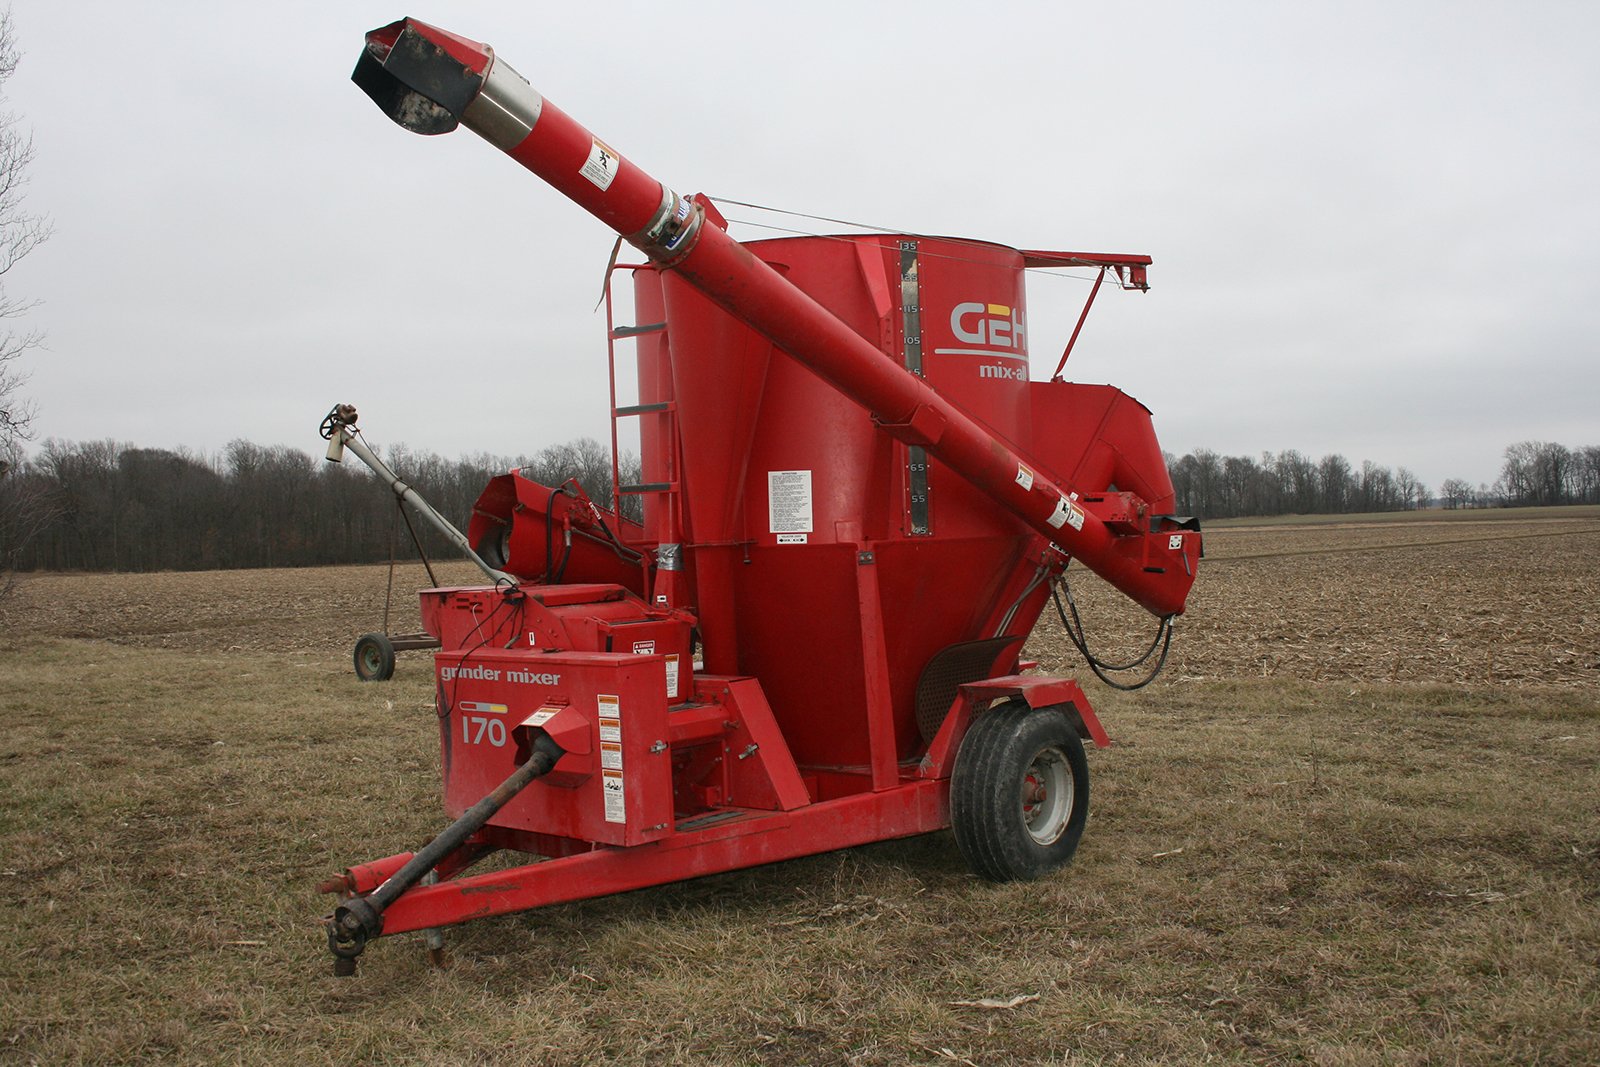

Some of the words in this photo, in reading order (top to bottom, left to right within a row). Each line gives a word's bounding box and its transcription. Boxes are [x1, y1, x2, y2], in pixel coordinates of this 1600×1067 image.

[900, 242, 916, 250] 135
[904, 305, 918, 313] 115
[903, 337, 920, 345] 105
[910, 463, 925, 472] 65
[911, 495, 925, 503] 55
[912, 526, 927, 535] 45
[441, 664, 501, 682] grinder
[506, 667, 561, 685] mixer
[463, 715, 507, 748] 170
